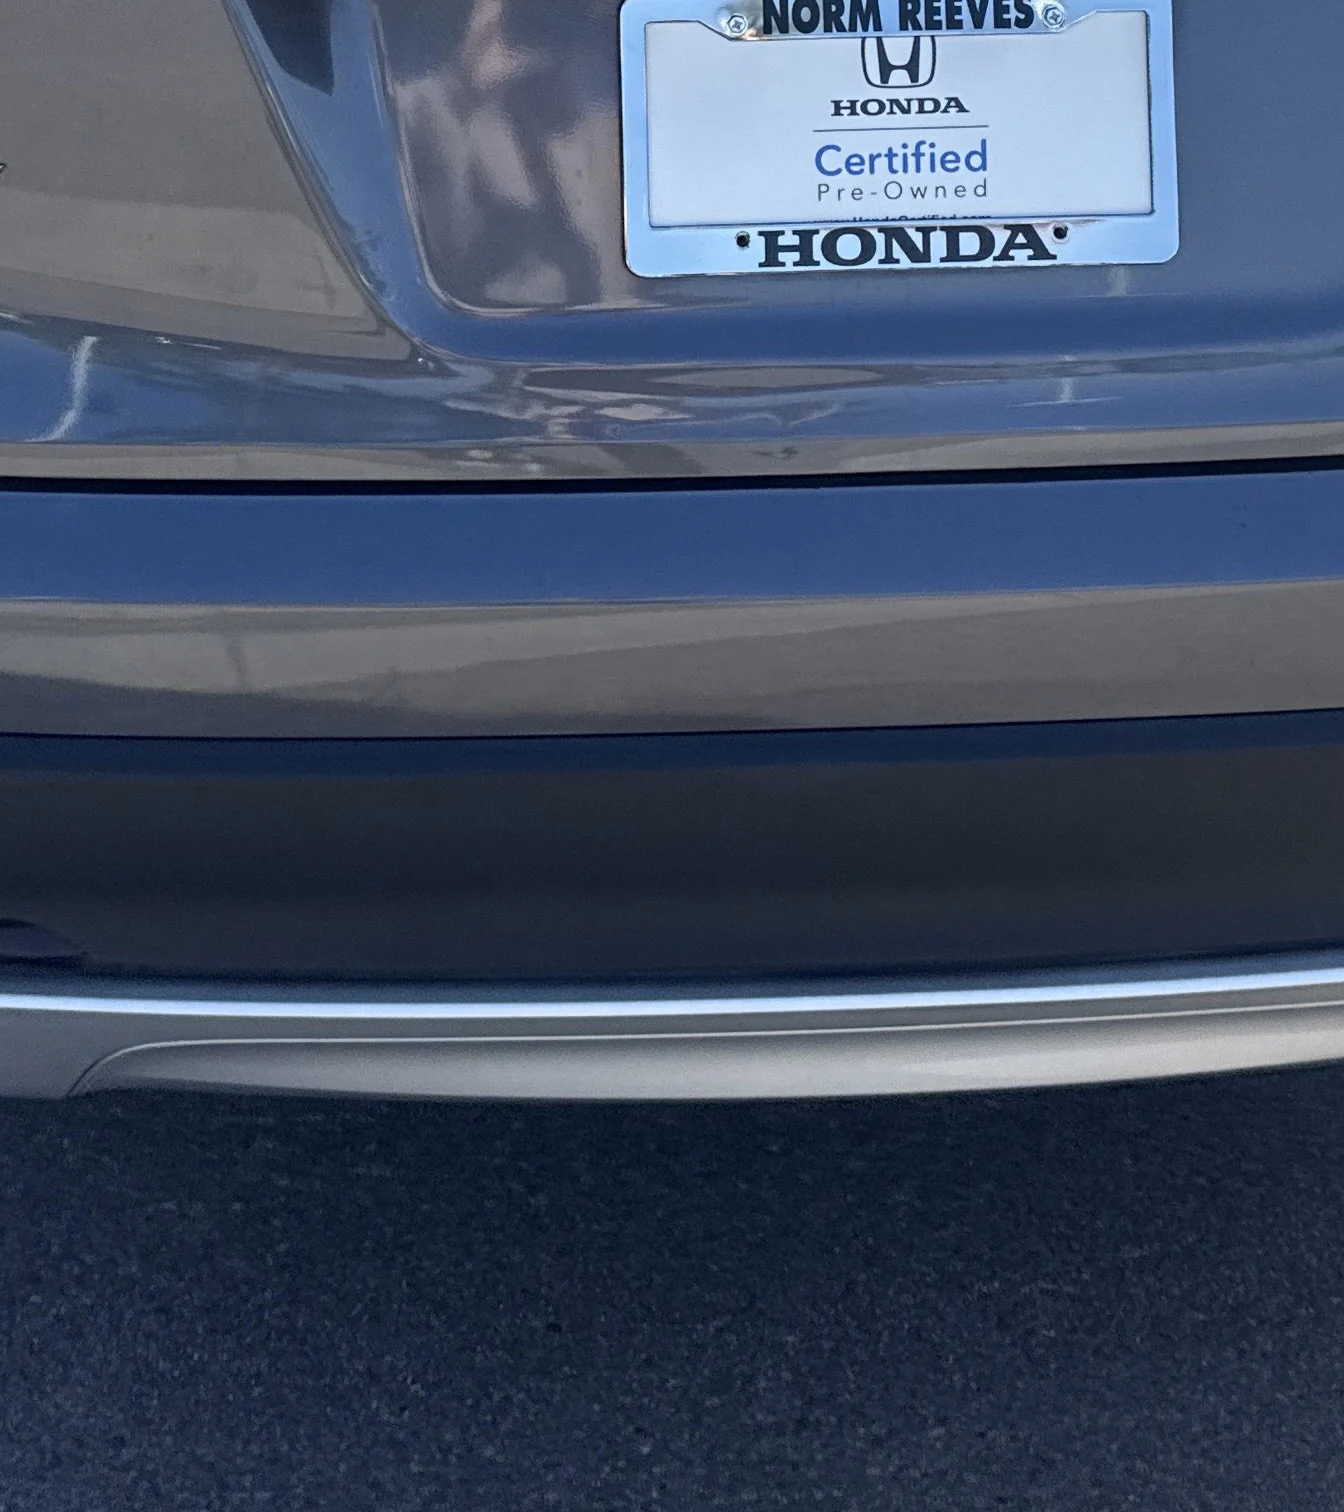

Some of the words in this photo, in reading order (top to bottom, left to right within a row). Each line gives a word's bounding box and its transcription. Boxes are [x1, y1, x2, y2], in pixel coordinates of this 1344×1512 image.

[830, 96, 970, 117] HONDA
[814, 138, 988, 176] Certified
[817, 178, 988, 202] Pre-Owned
[757, 223, 1057, 268] HONDA
